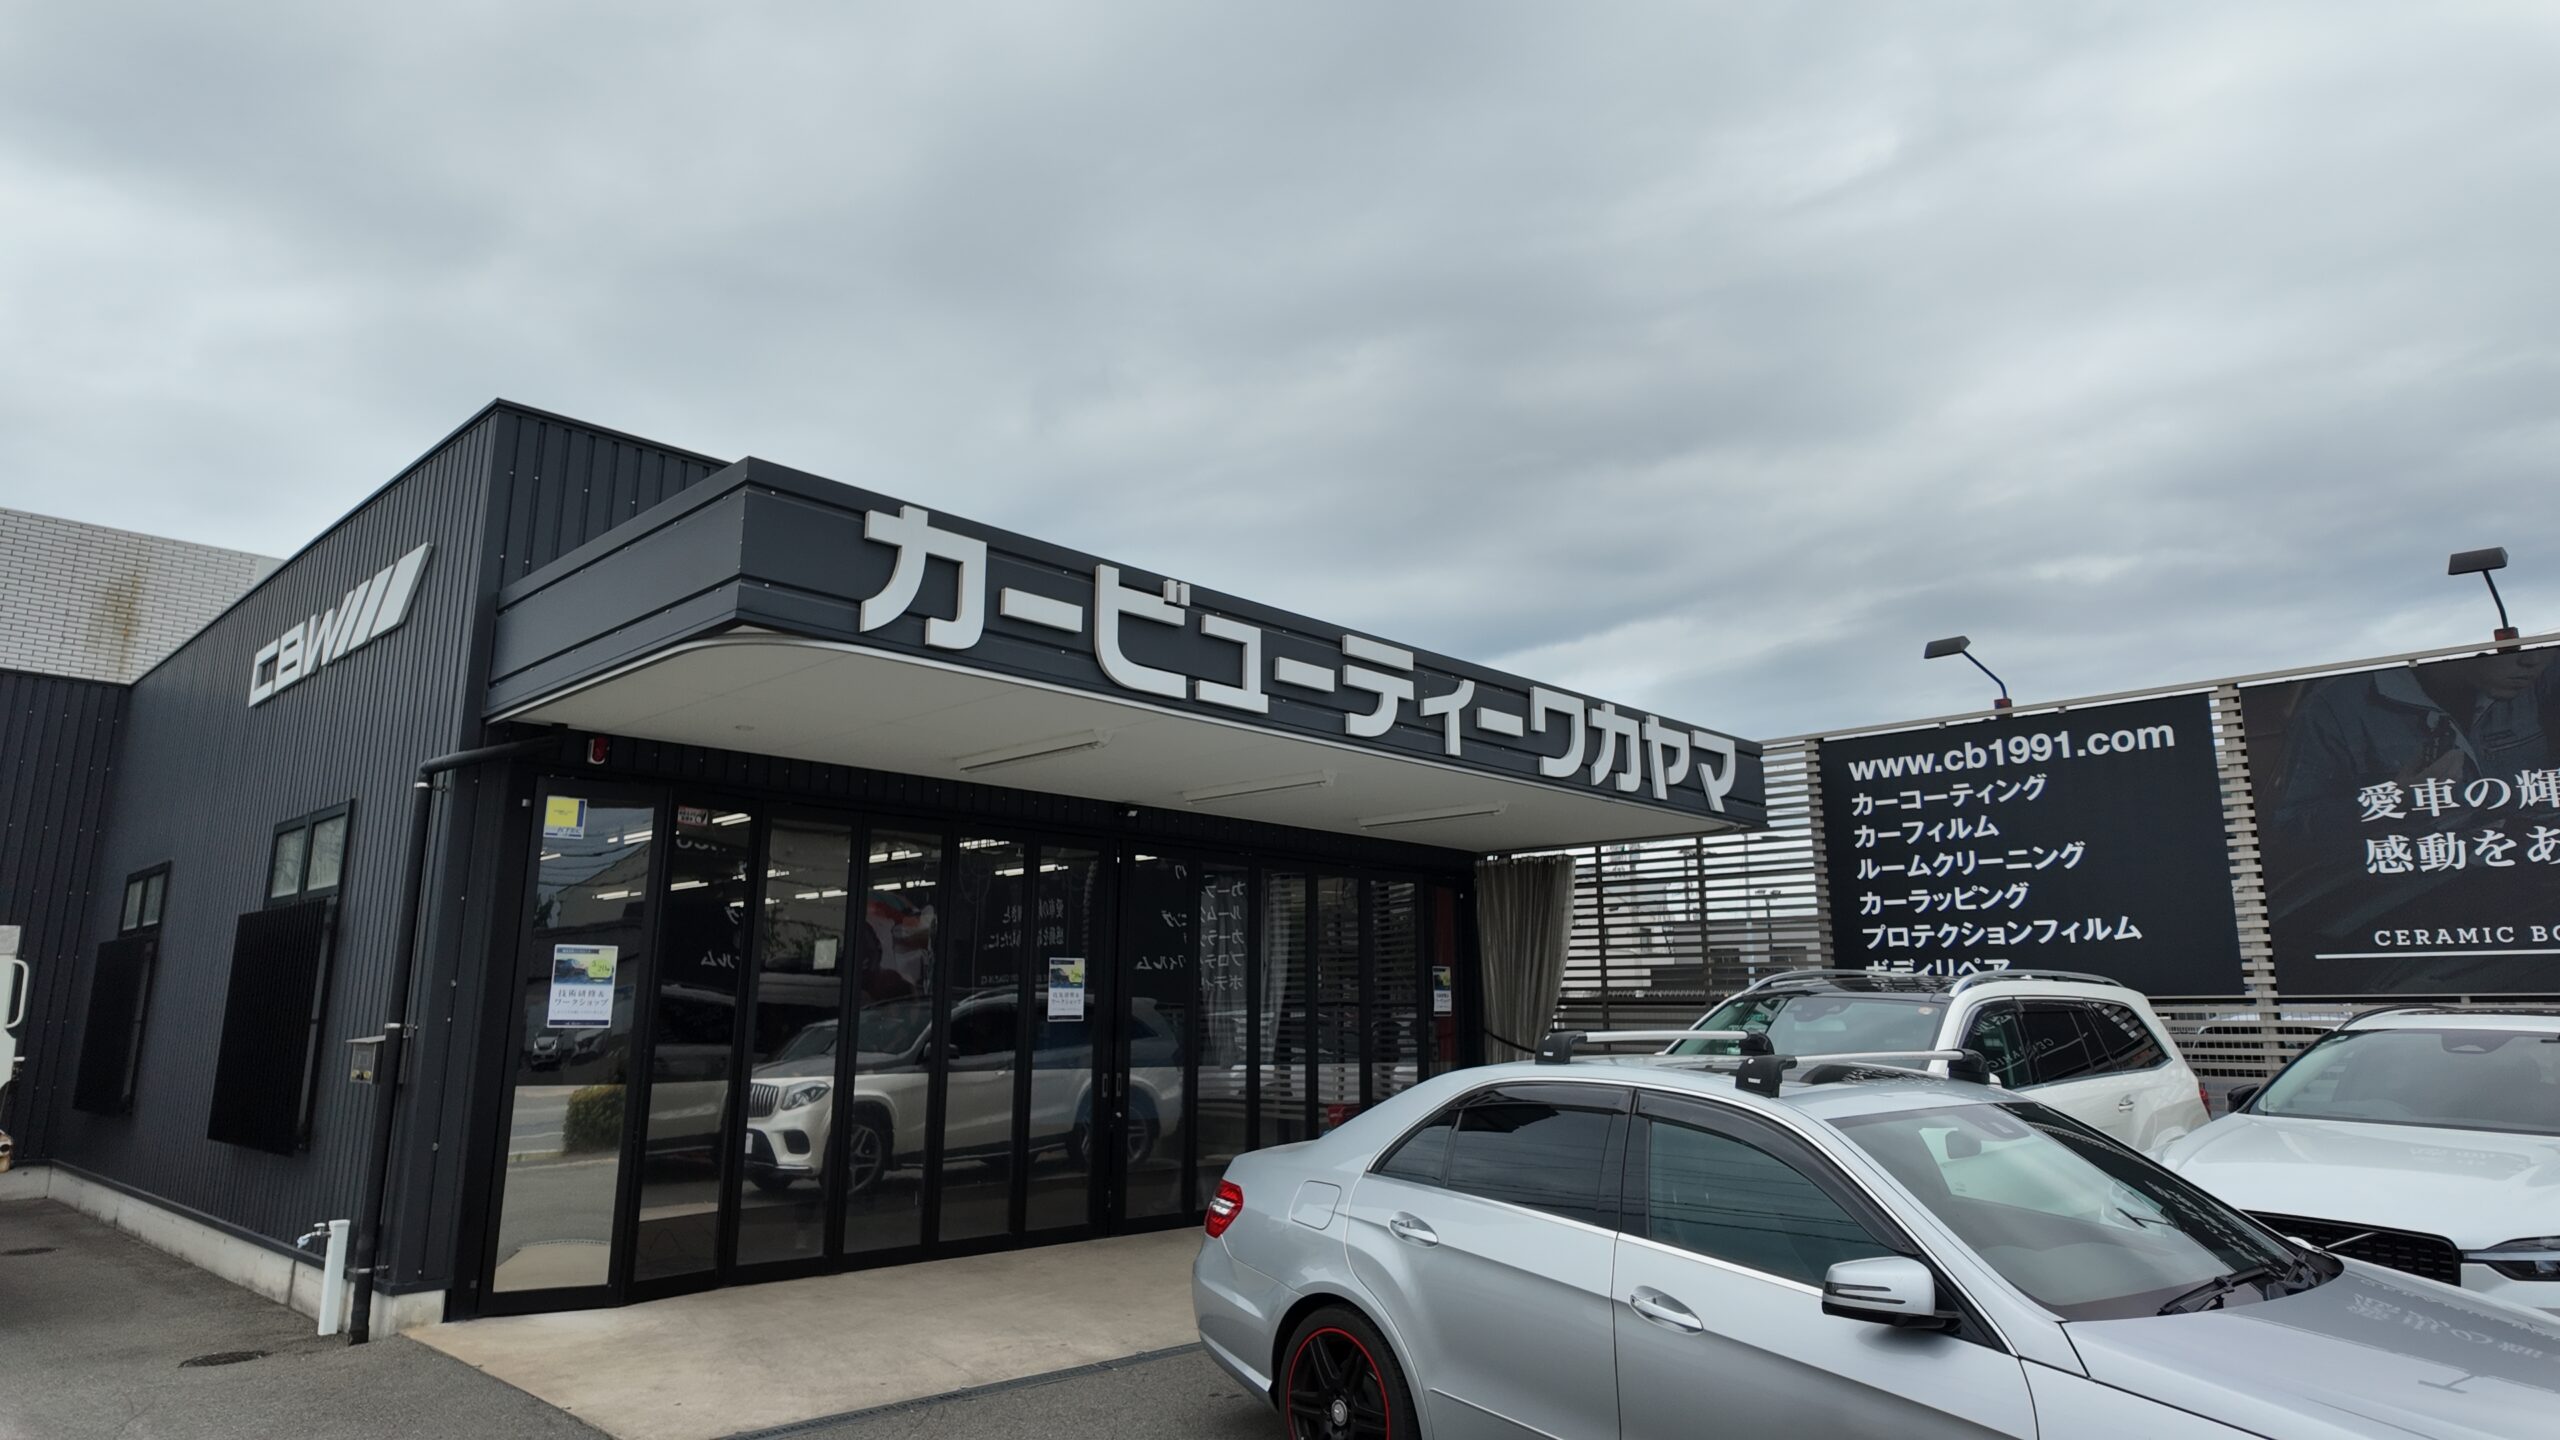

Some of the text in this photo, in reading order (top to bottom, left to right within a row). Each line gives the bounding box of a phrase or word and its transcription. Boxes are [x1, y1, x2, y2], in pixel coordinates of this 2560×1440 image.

[859, 505, 1737, 813] カービューティーワカヤマ
[1848, 723, 2176, 782] www.cb1991.com
[1851, 772, 2047, 816] カーコーティング
[2357, 768, 2560, 823] 愛車の輝
[1853, 814, 2000, 849] カーフィルム
[2365, 825, 2560, 875] 感動をあ
[1857, 840, 2086, 880] ルームクリーニング
[1859, 881, 2029, 916] カーラッピング
[1862, 915, 2143, 950] プロテクションフィルム
[2374, 926, 2516, 946] CERAMIC
